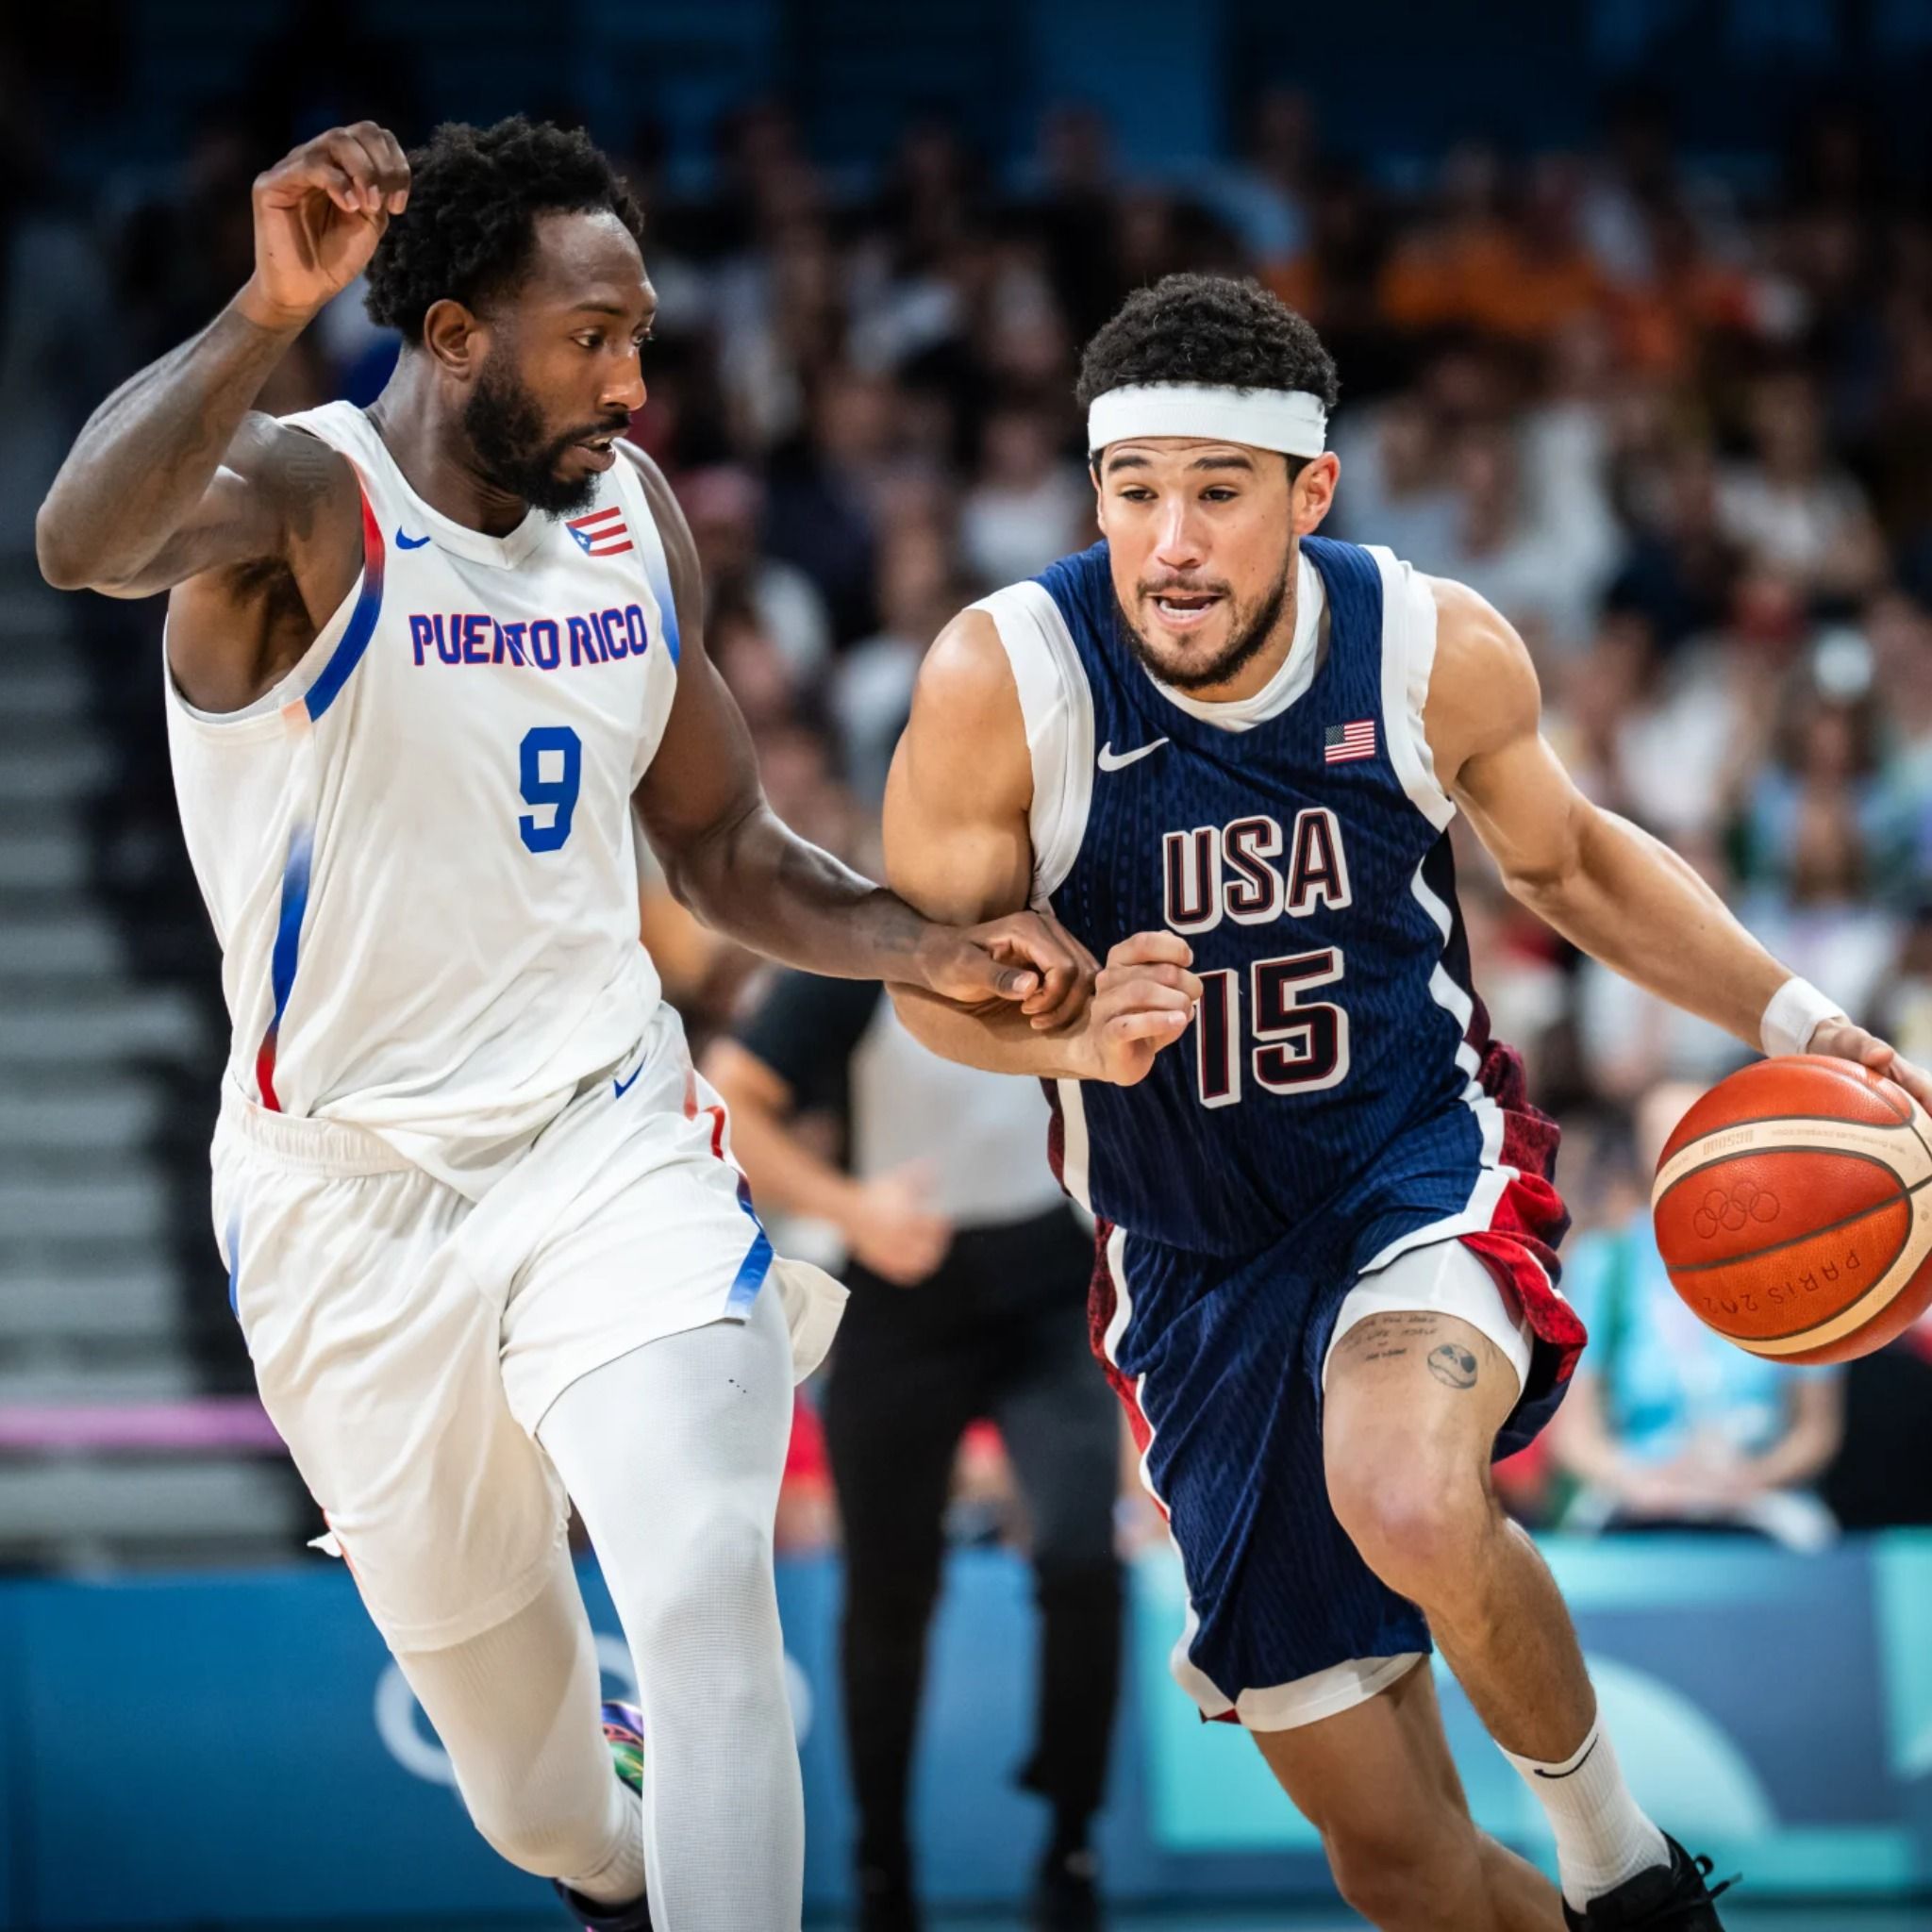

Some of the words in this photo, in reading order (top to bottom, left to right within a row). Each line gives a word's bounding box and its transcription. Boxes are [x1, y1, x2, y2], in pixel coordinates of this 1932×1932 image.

[408, 613, 560, 671] PUERTO
[565, 604, 648, 667] RICO
[519, 725, 582, 854] 9
[1162, 807, 1353, 936] USA
[1192, 945, 1350, 1109] 15
